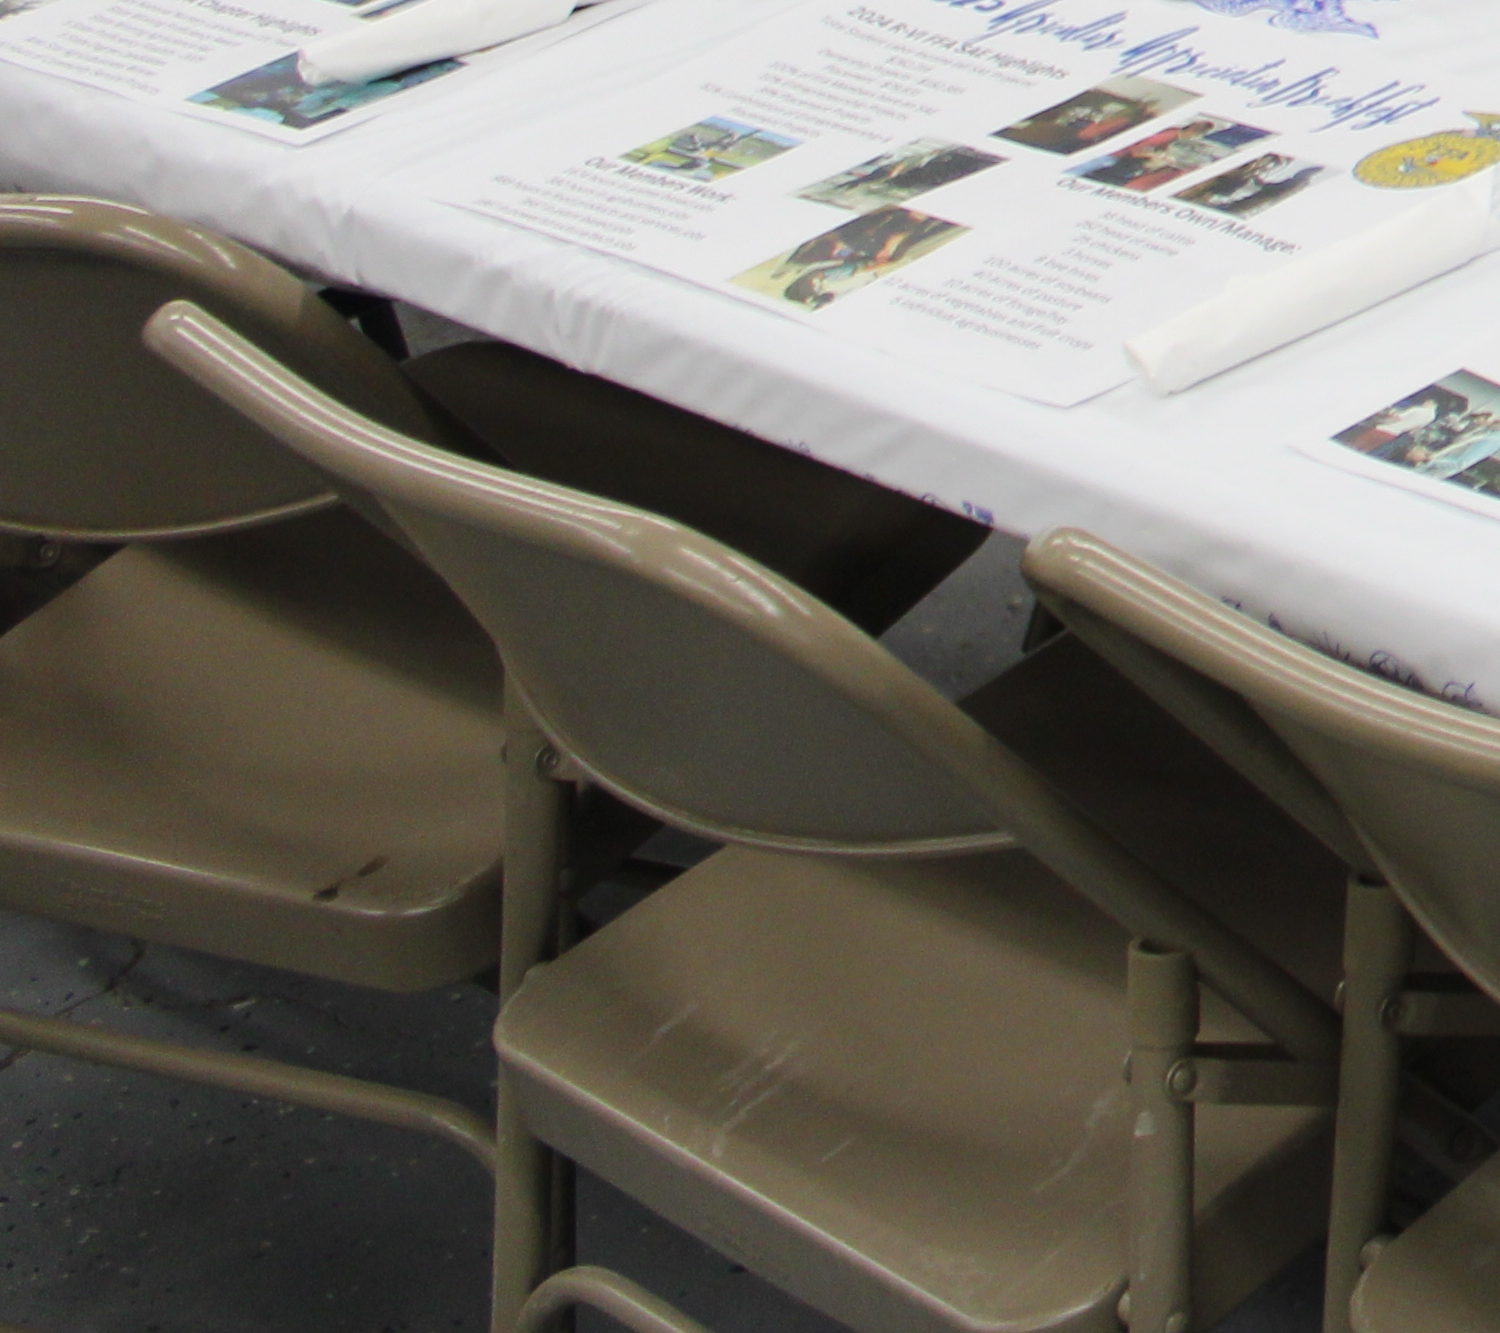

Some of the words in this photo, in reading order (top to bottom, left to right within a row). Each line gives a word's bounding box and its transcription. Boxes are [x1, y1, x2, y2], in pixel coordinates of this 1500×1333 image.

[847, 6, 892, 27] 2024
[889, 19, 930, 41] R-VI
[925, 32, 958, 50] FFA
[957, 43, 988, 59] SAE
[988, 52, 1071, 80] Highlights
[1112, 27, 1285, 93] Appreciation
[1248, 67, 1440, 132] Breakfast
[584, 156, 618, 171] Our
[616, 164, 688, 191] Members
[1057, 177, 1094, 198] Our
[1090, 186, 1172, 214] Members
[1173, 204, 1302, 256] Own/Manage:
